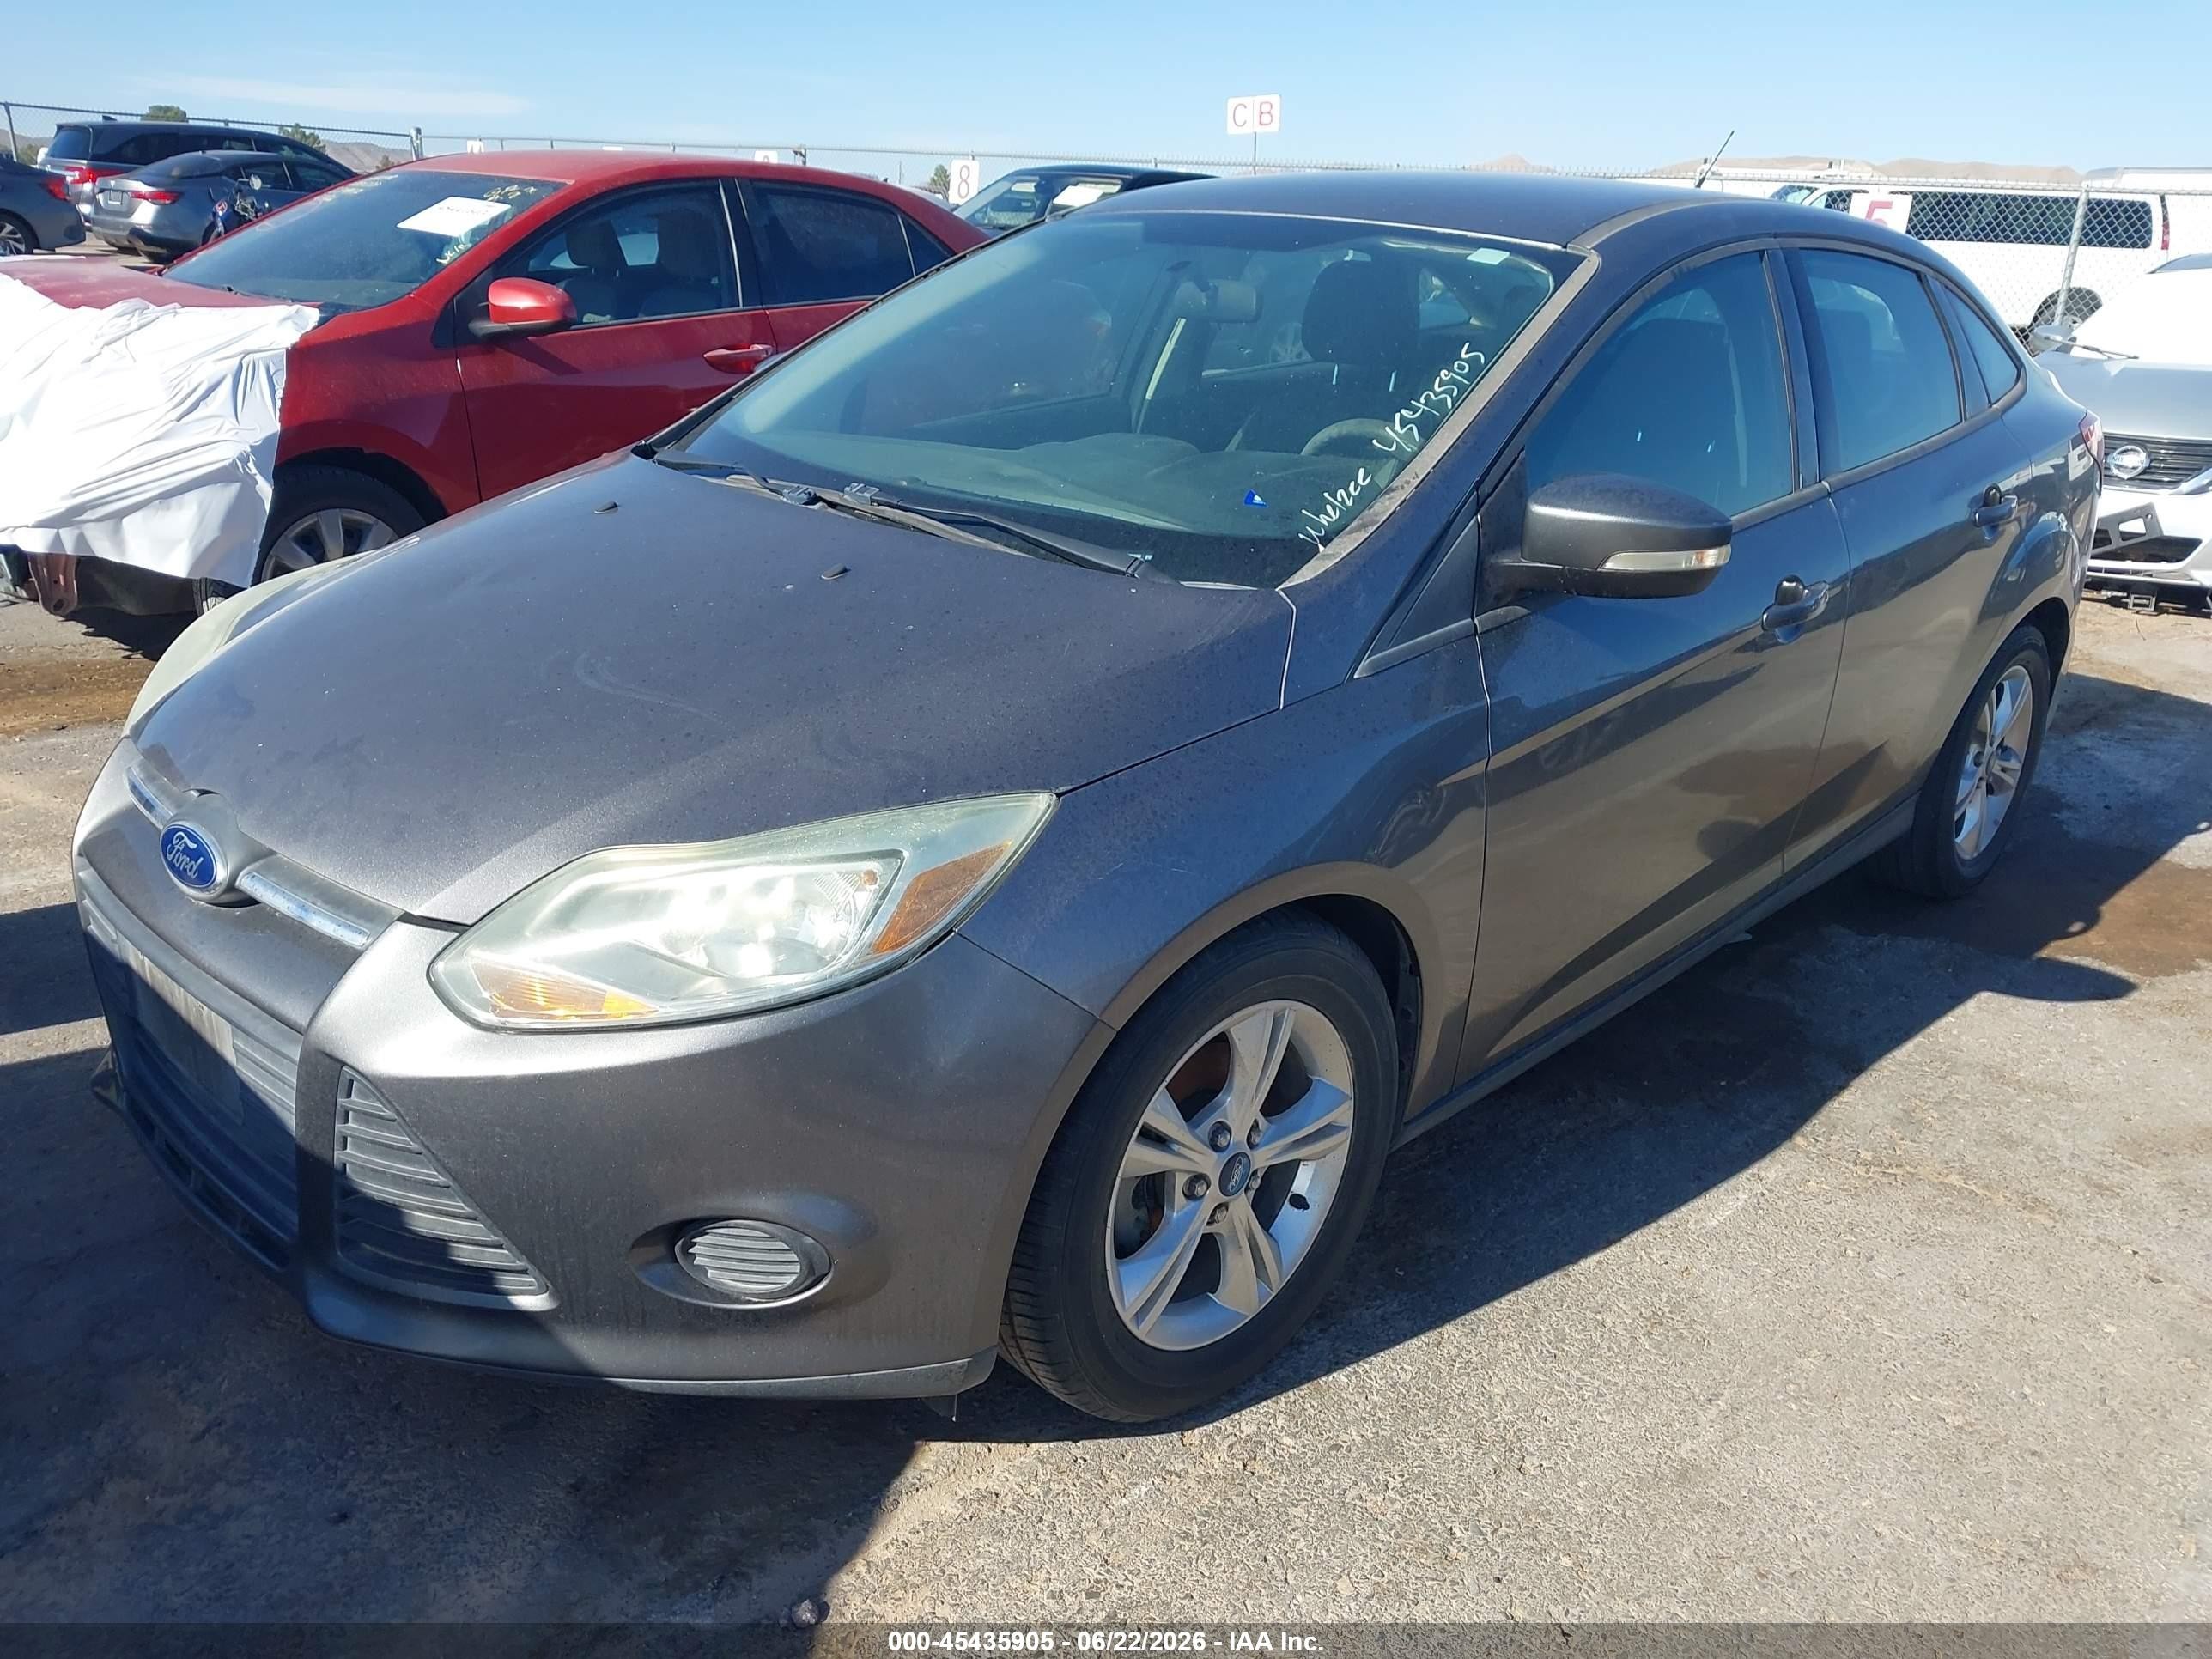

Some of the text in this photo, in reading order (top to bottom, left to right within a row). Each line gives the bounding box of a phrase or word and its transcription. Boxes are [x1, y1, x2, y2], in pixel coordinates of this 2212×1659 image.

[1232, 100, 1274, 127] C B
[957, 163, 971, 200] 8
[1371, 341, 1486, 453] 45435905
[166, 830, 204, 880] Ford
